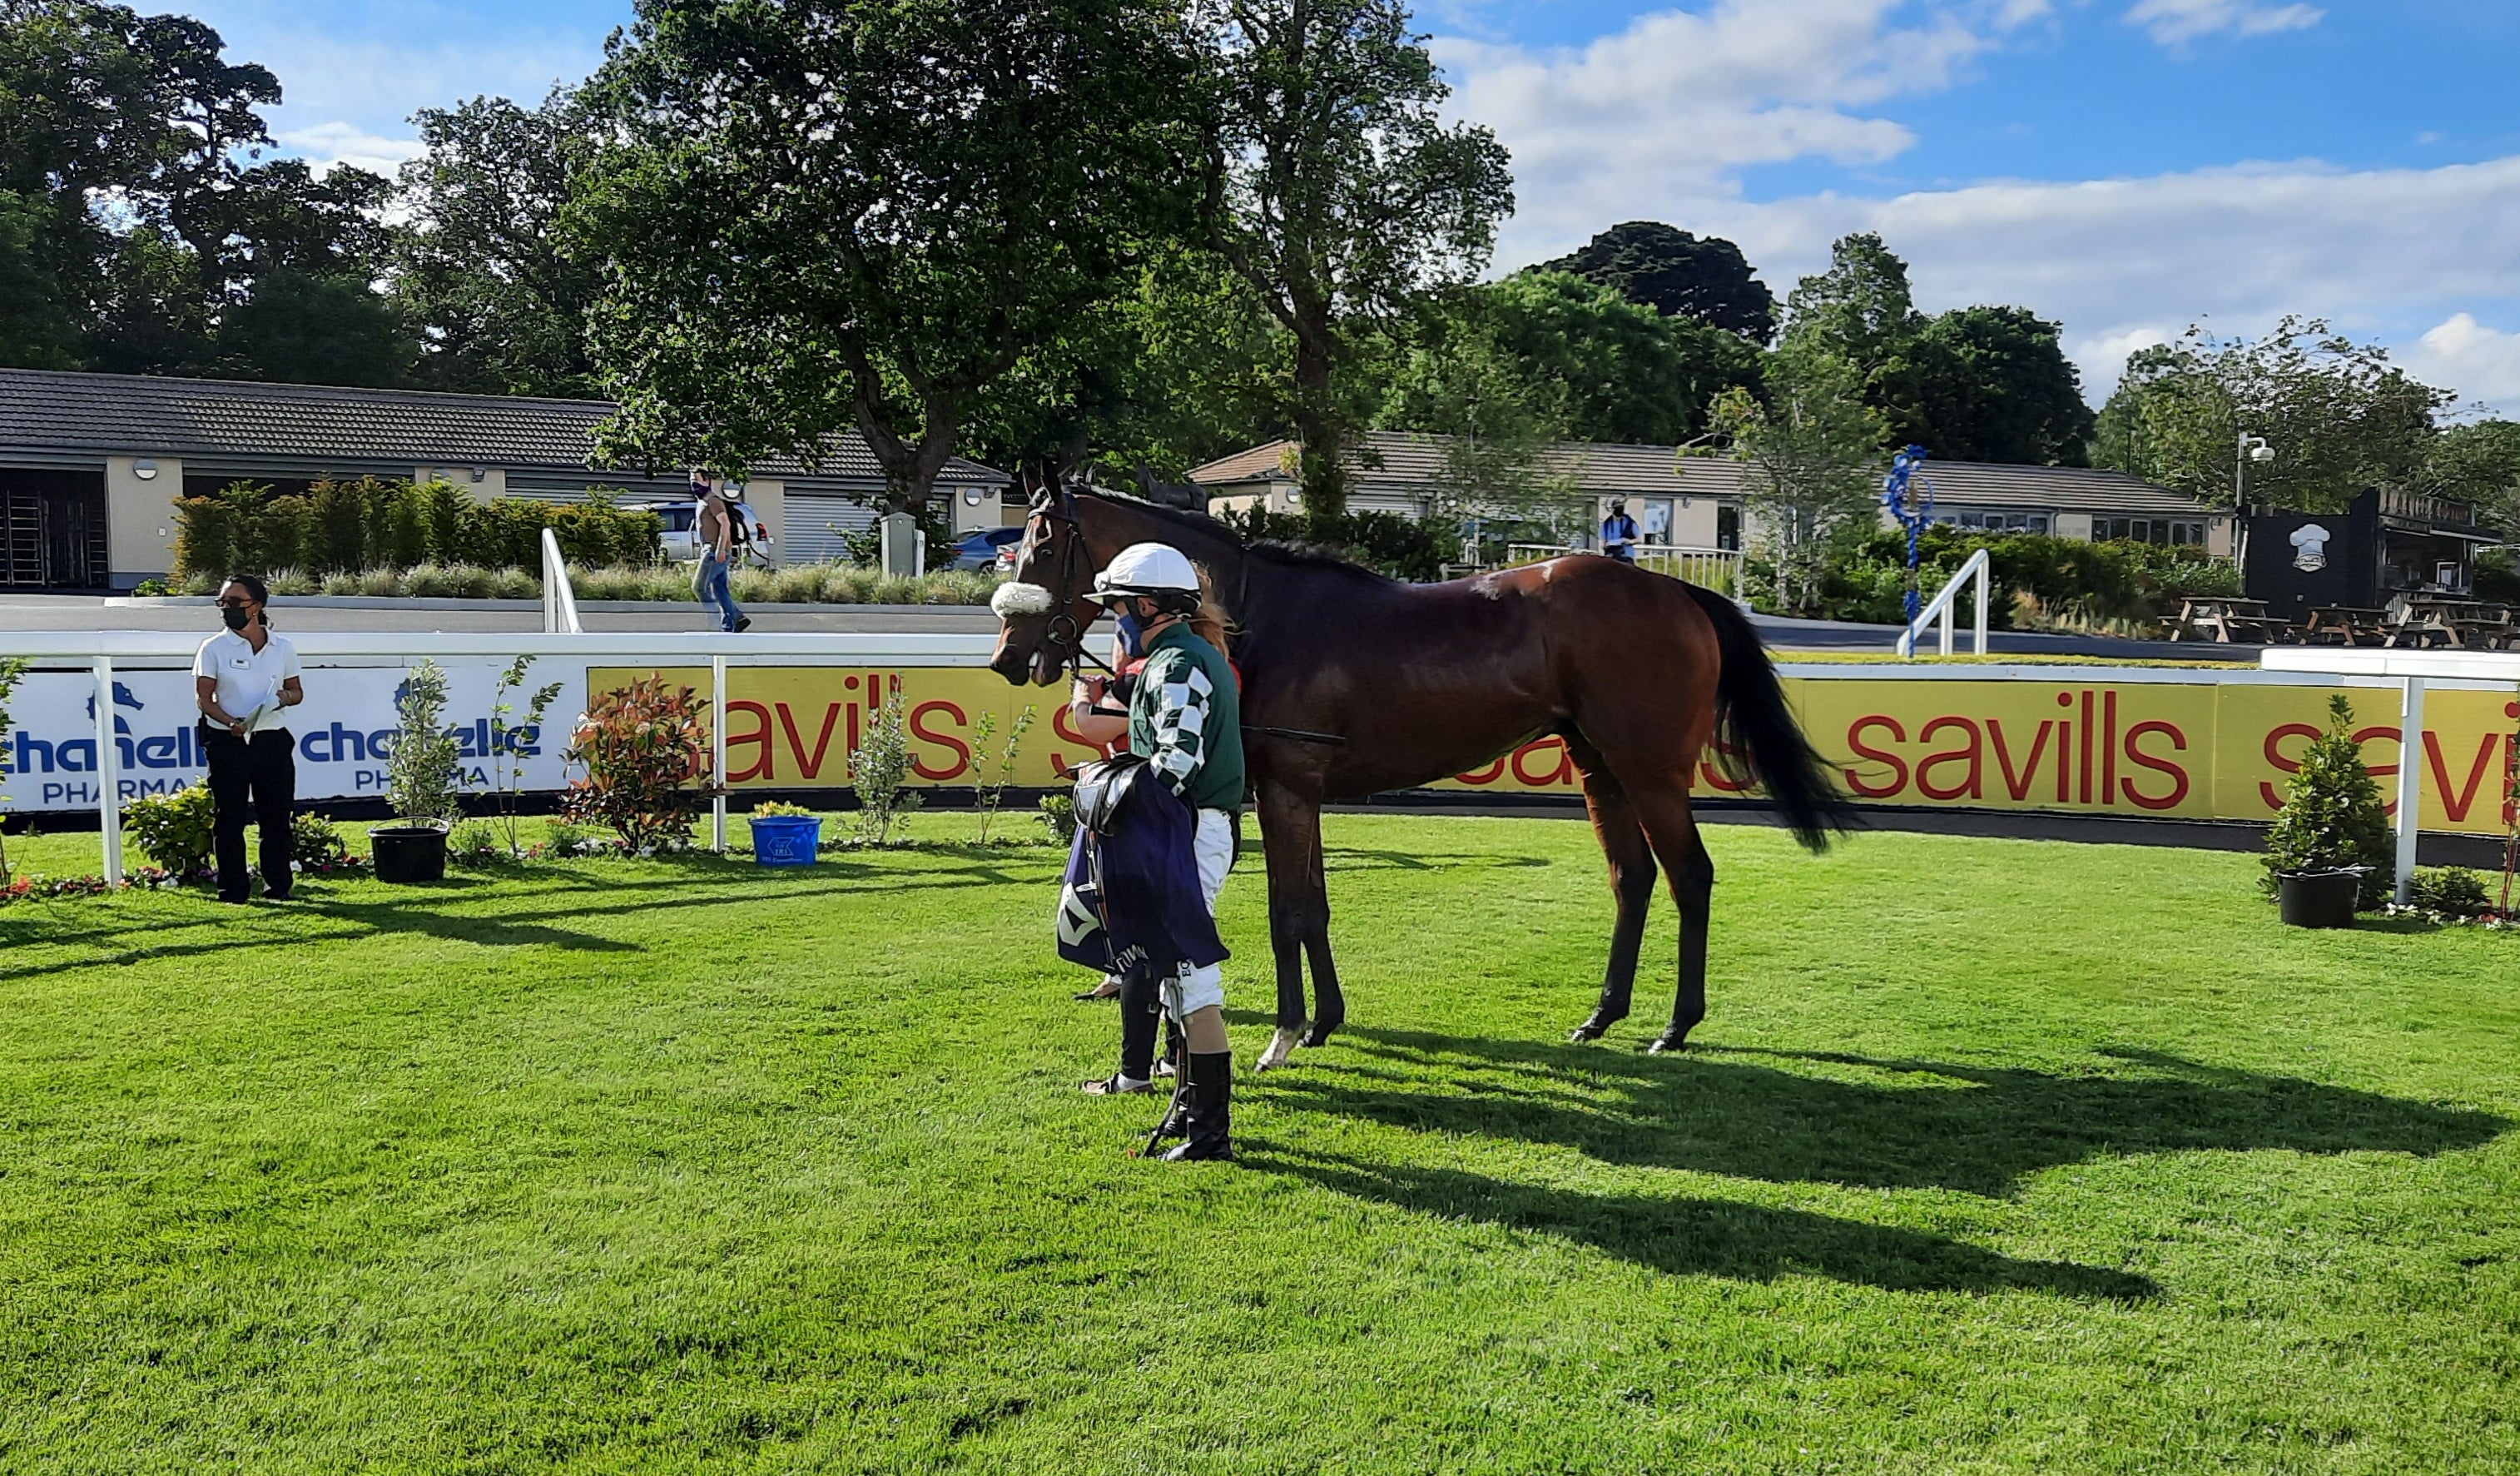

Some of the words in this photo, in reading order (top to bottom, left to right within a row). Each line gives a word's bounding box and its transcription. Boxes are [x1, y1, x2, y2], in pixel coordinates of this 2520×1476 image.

[0, 725, 207, 773] hanell
[300, 718, 541, 762] chaelle
[1844, 689, 2189, 810] savills
